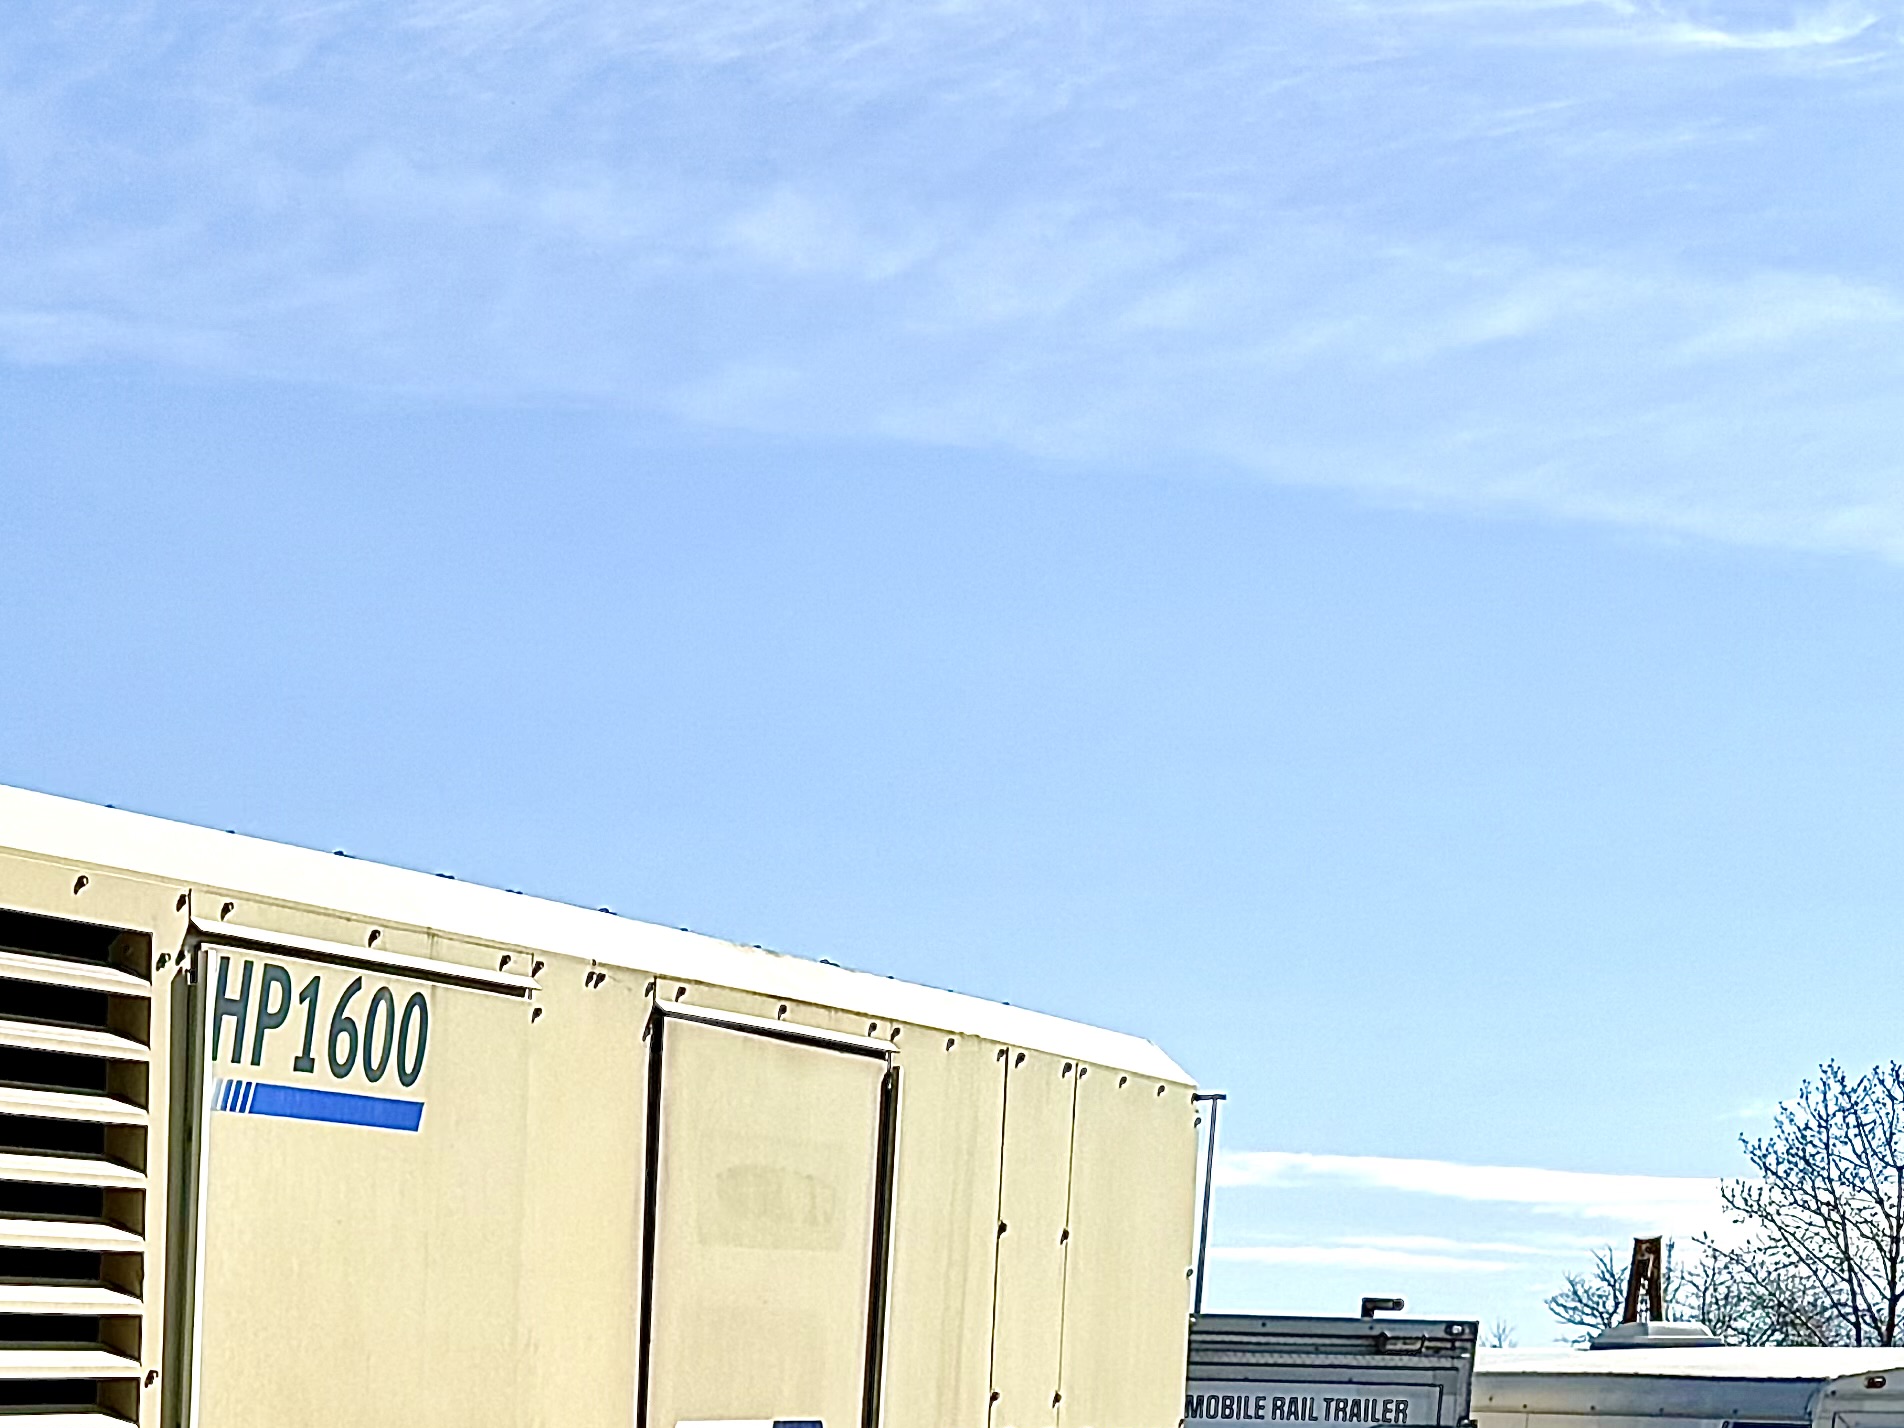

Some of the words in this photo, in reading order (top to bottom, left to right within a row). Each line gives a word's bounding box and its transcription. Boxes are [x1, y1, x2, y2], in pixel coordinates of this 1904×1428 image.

[211, 956, 430, 1088] HP1600
[1185, 1394, 1267, 1420] MOBILE
[1271, 1396, 1318, 1422] RAIL
[1323, 1397, 1409, 1424] TRAILER
